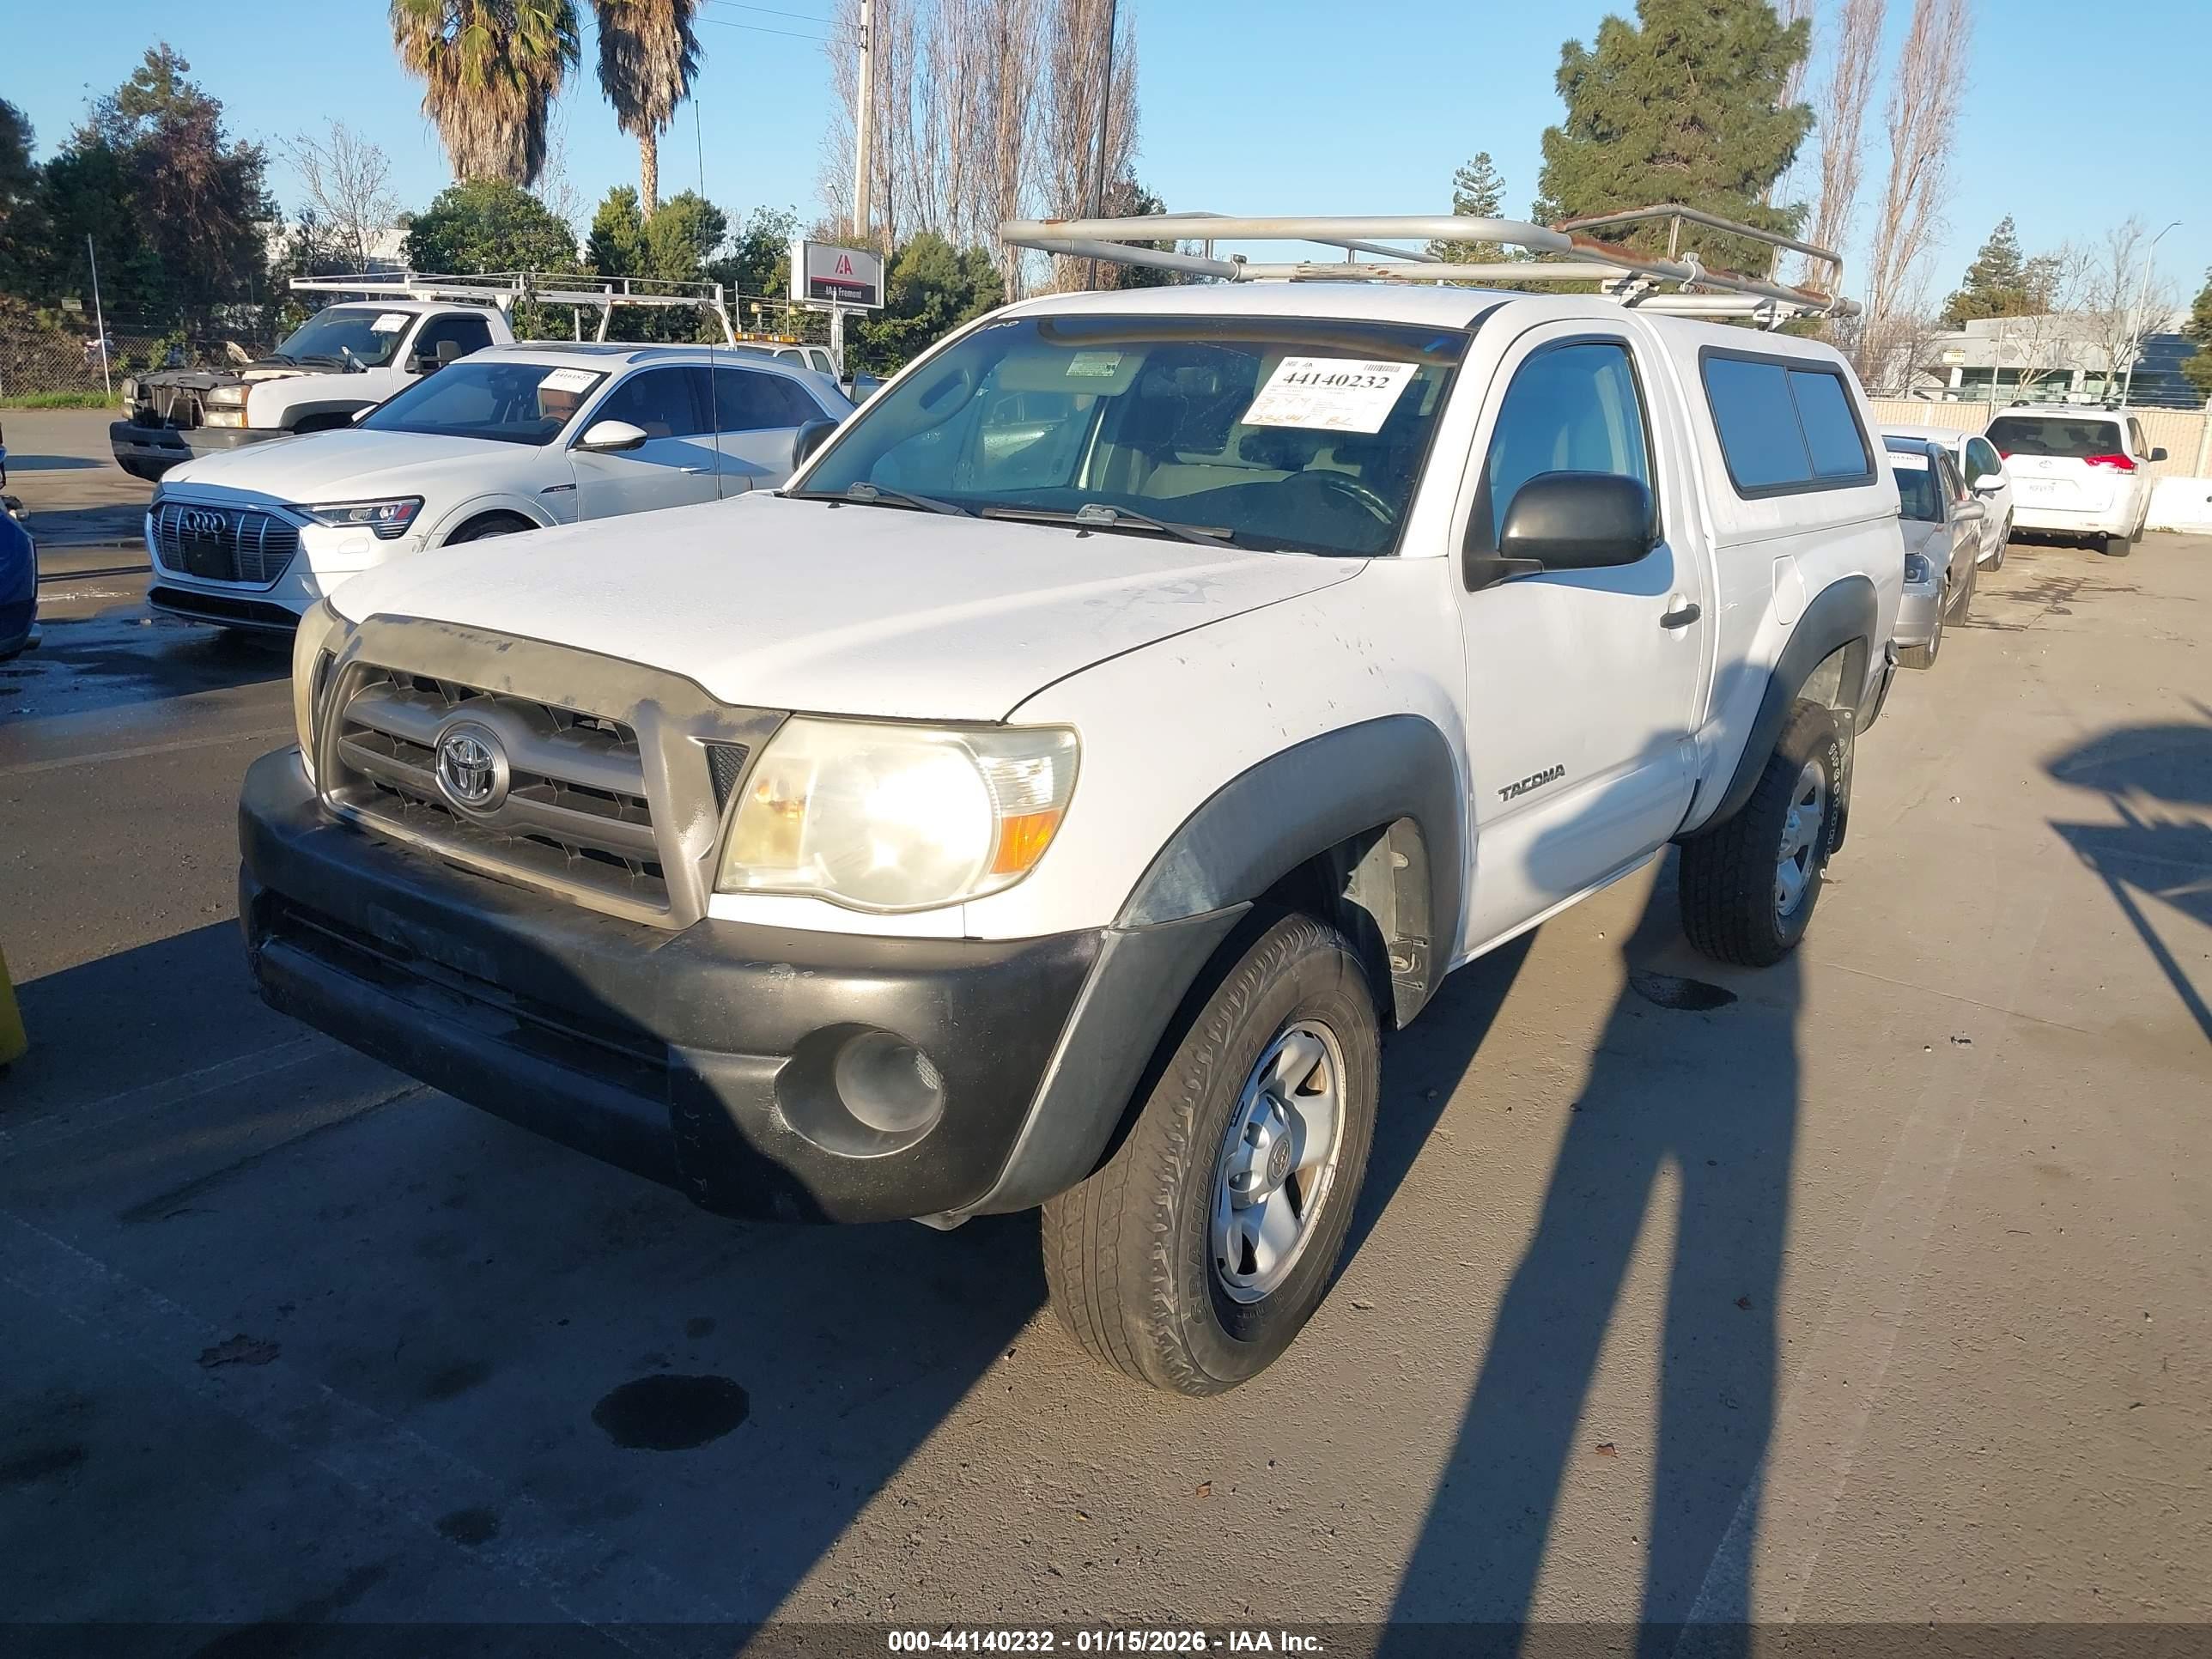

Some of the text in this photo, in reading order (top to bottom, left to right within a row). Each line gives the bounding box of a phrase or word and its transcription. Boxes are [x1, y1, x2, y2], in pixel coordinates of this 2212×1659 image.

[825, 285, 862, 299] IAA Fremont
[1283, 372, 1389, 389] 44140232
[1498, 763, 1566, 802] TACOMA
